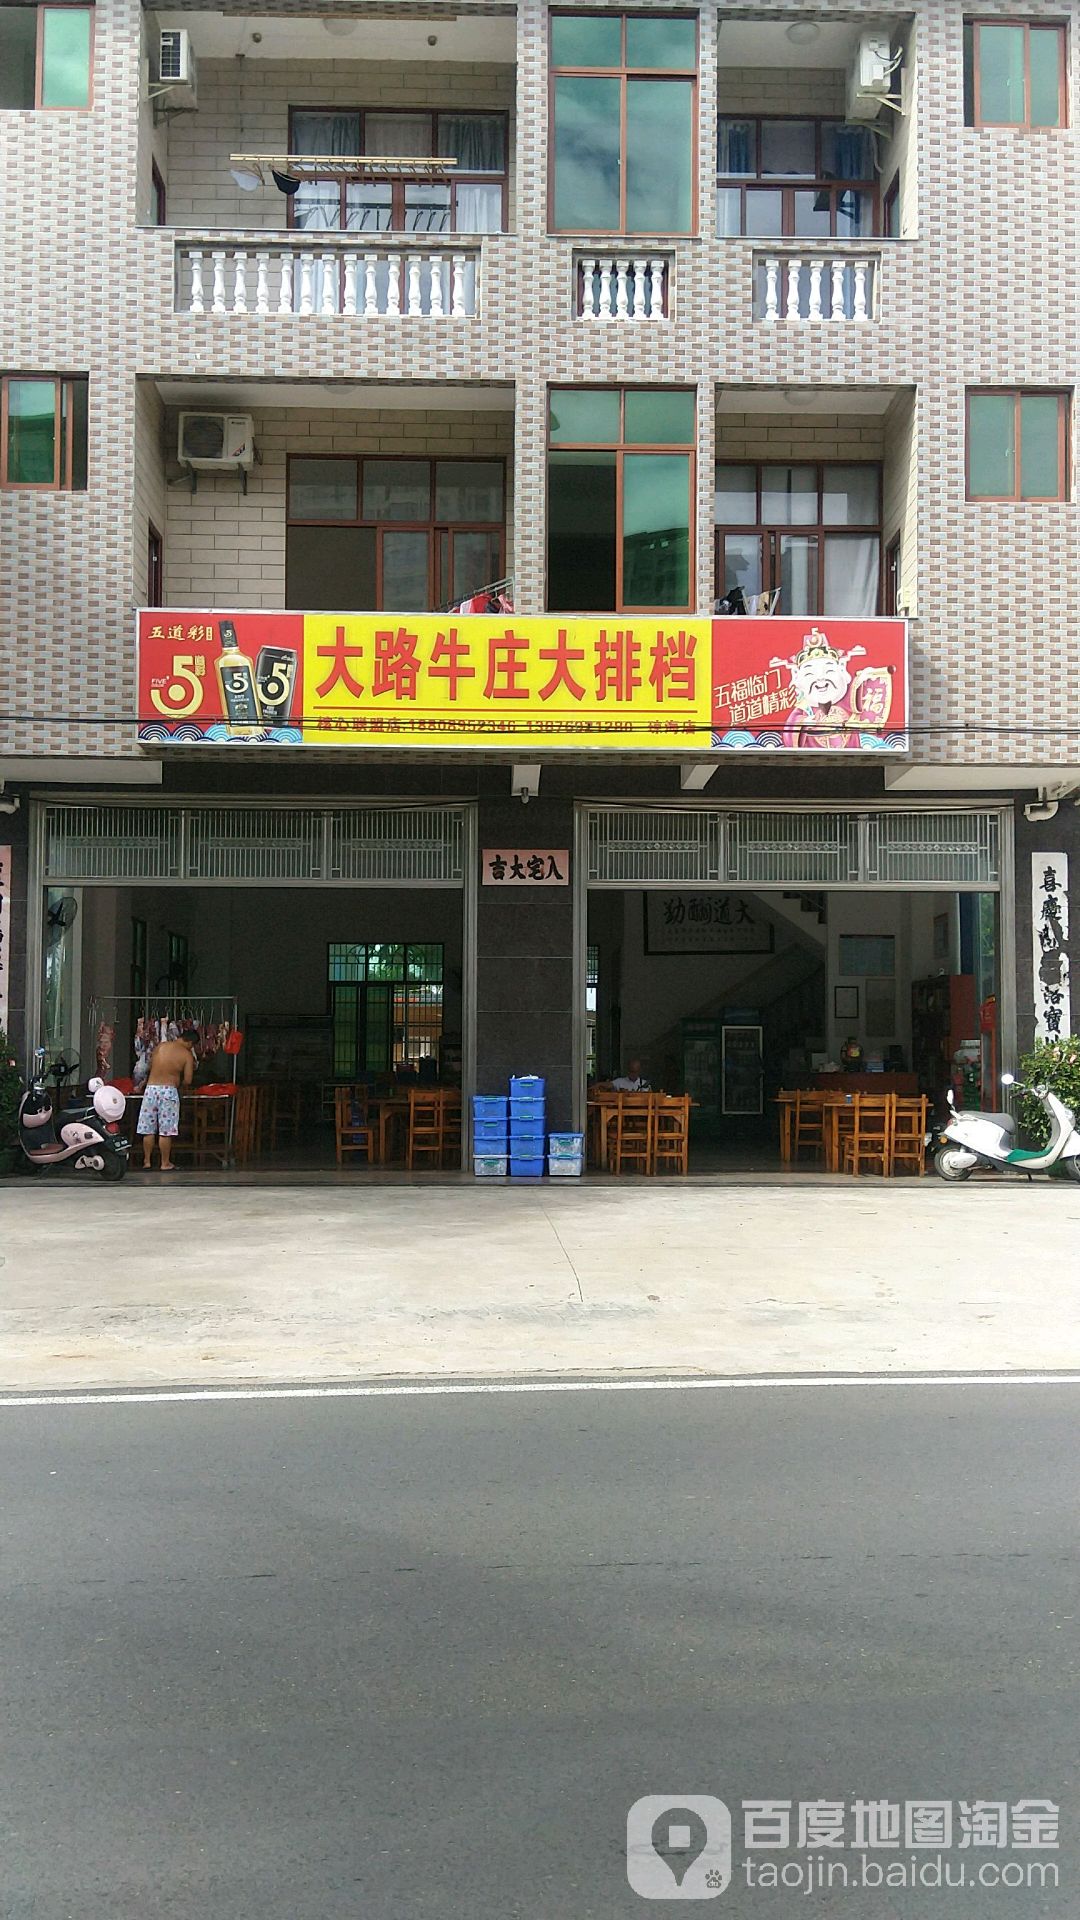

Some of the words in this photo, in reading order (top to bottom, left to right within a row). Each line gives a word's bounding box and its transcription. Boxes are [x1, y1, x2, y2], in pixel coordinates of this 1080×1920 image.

[147, 624, 205, 641] 五道彩
[315, 626, 698, 702] 大路牛庄大排档
[714, 668, 782, 709] 五福临门
[863, 687, 885, 712] 福
